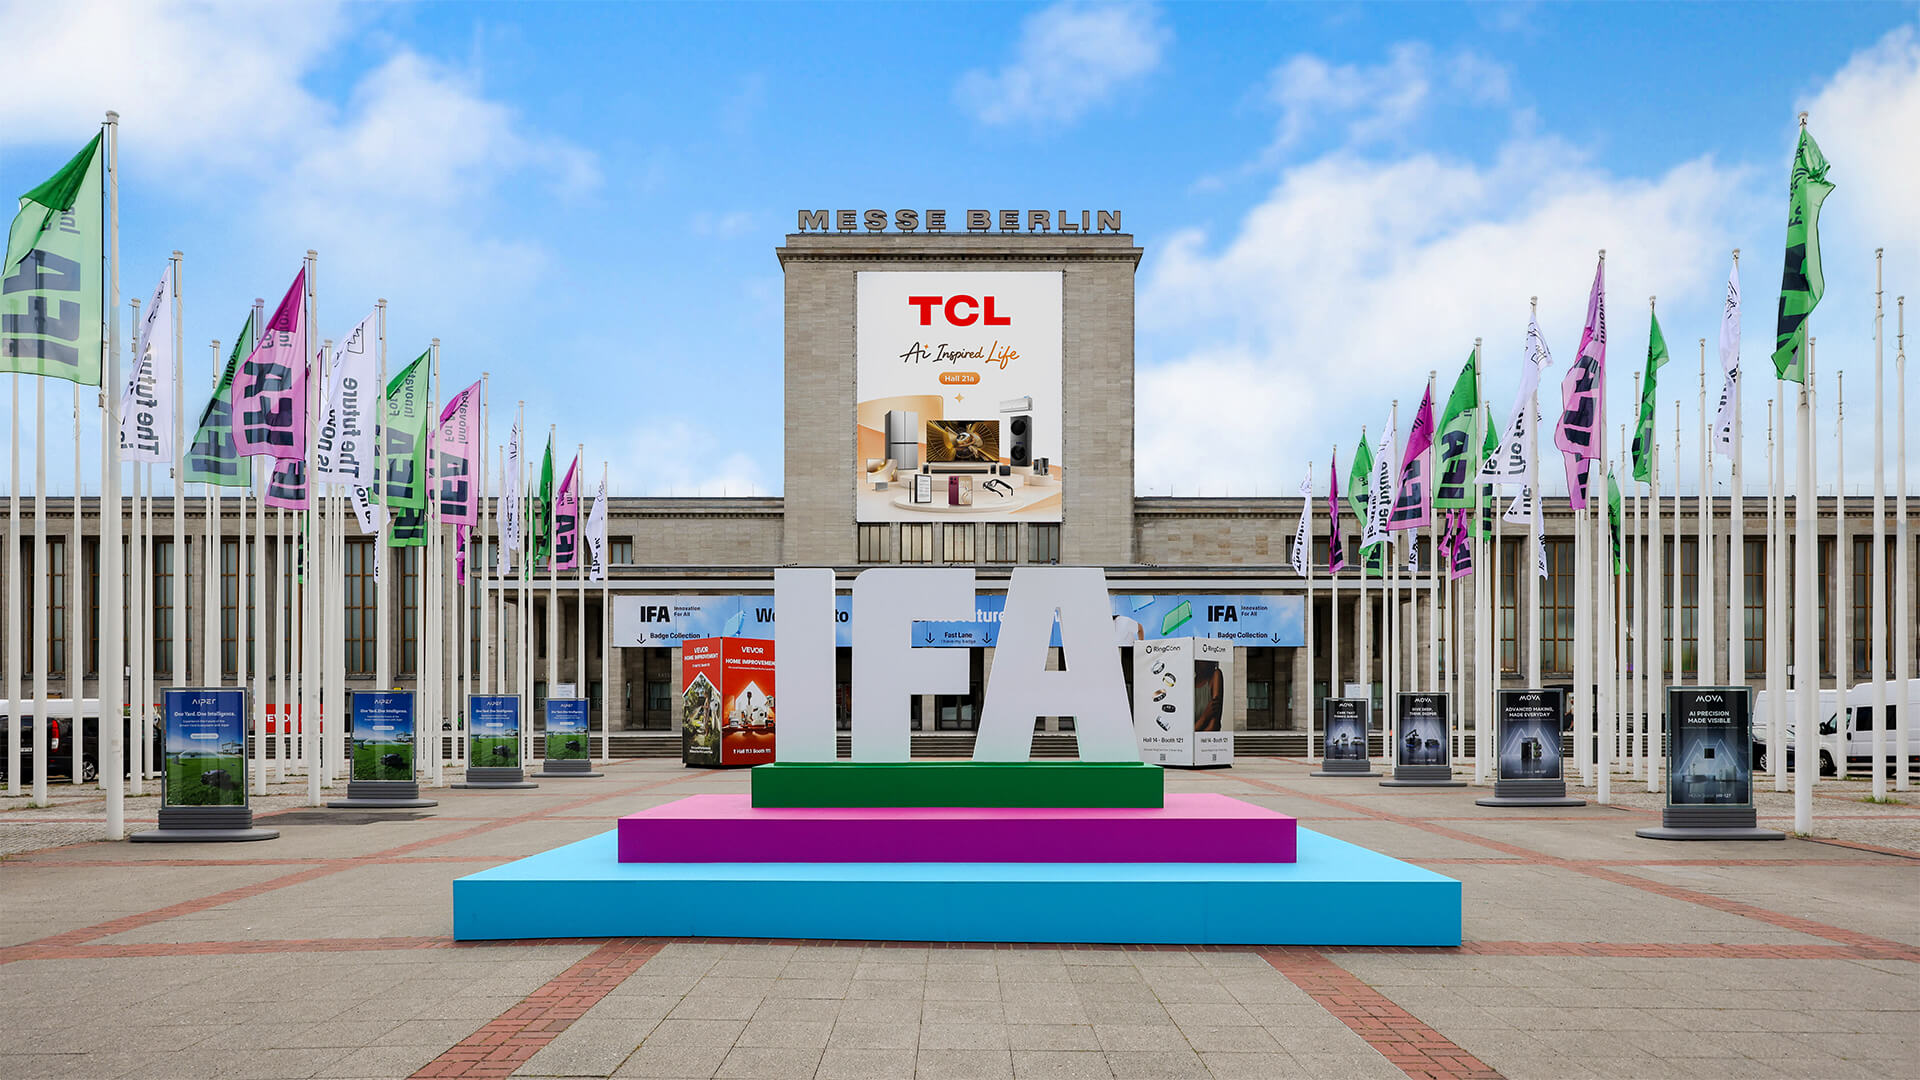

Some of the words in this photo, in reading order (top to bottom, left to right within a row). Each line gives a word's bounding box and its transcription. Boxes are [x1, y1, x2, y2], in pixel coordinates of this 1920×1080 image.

[798, 210, 946, 230] MESSE
[967, 210, 1121, 231] BERLIN
[908, 294, 1011, 327] TCL
[900, 341, 931, 364] Ai
[933, 343, 984, 364] Inspired
[985, 340, 1020, 370] Life
[944, 375, 961, 383] Hall
[961, 375, 975, 383] 21a
[640, 606, 670, 622] IFA
[1208, 605, 1238, 622] IFA
[741, 646, 764, 654] VEVOR
[774, 567, 1141, 763] IFA
[1695, 694, 1723, 702] MOVA
